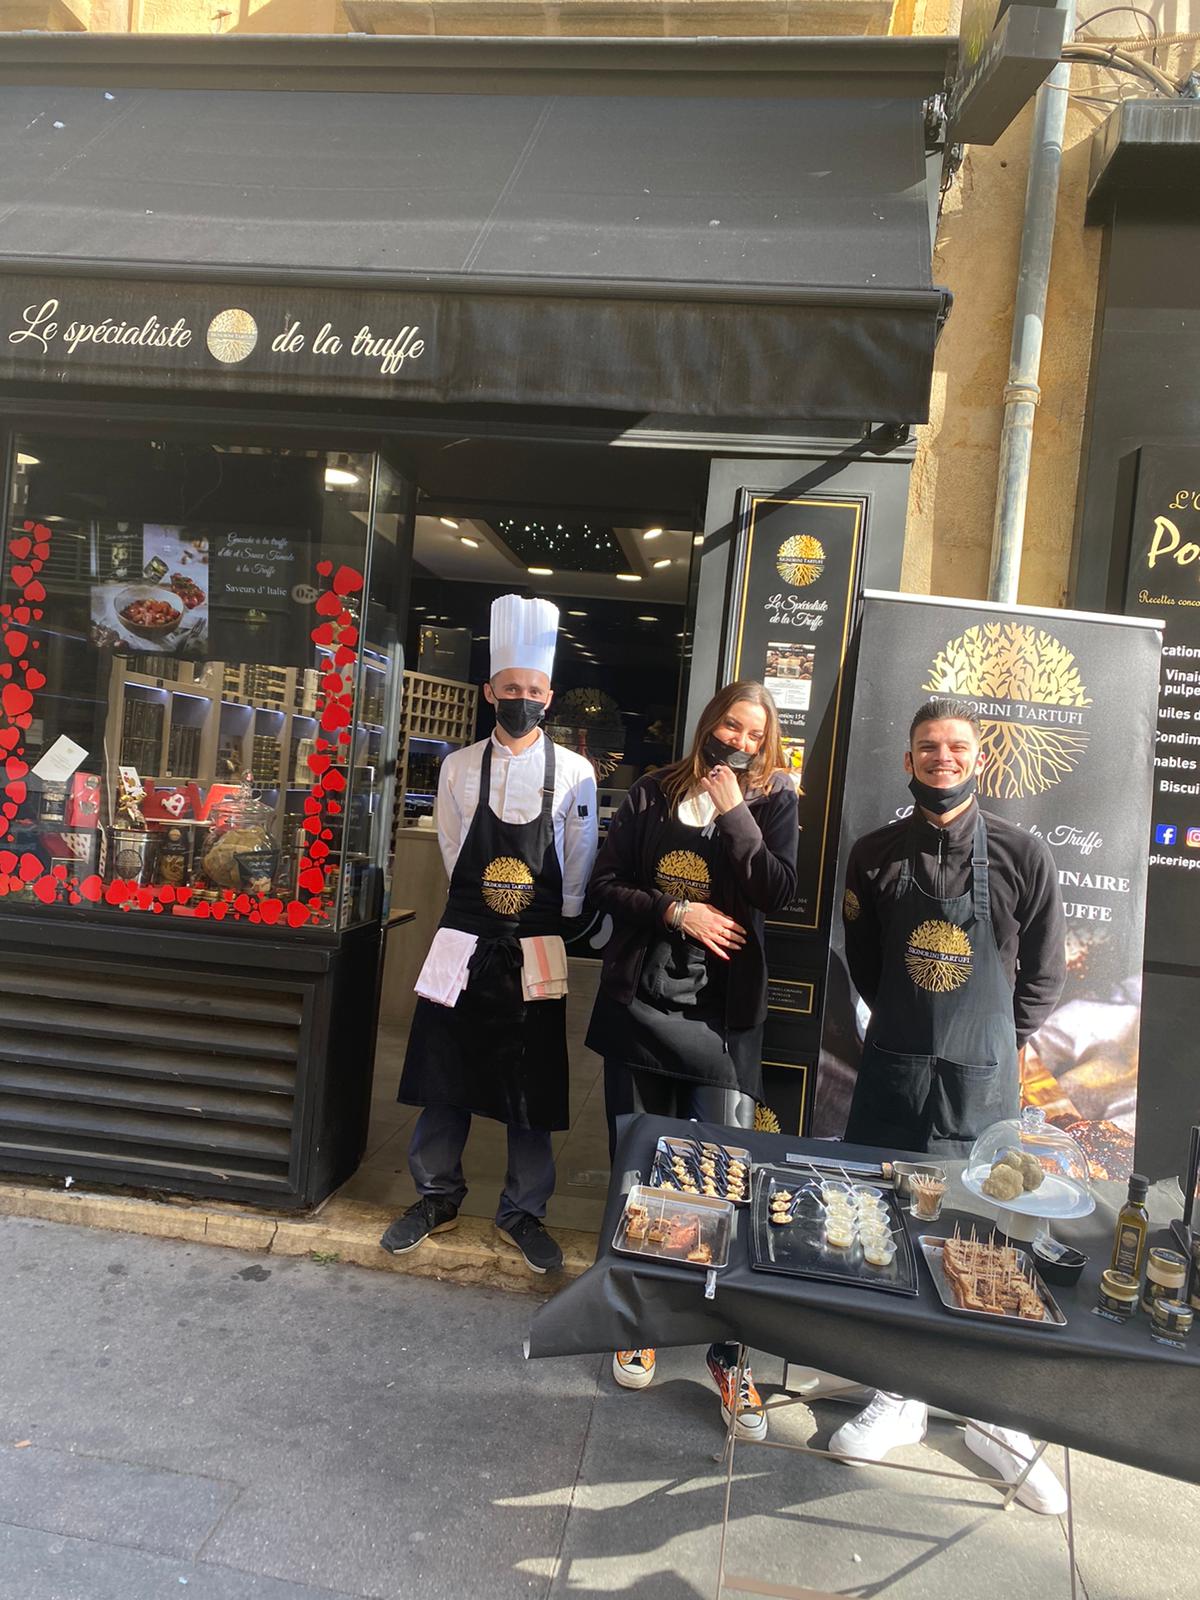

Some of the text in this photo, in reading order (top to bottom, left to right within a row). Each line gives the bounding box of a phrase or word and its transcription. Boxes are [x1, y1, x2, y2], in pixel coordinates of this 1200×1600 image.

[9, 299, 425, 374] Le spécialiste de la truffe
[225, 584, 256, 594] Saveurs
[267, 587, 288, 597] Italie
[1138, 589, 1175, 606] Recettes
[764, 593, 782, 612] Le
[769, 612, 824, 631] de la Truffe
[929, 695, 1083, 725] SORINI TARTUFI
[1047, 825, 1104, 855] Truffe
[1058, 870, 1130, 894] INAIRE
[1063, 902, 1113, 921] UFFE
[940, 953, 970, 963] TARTUFI
